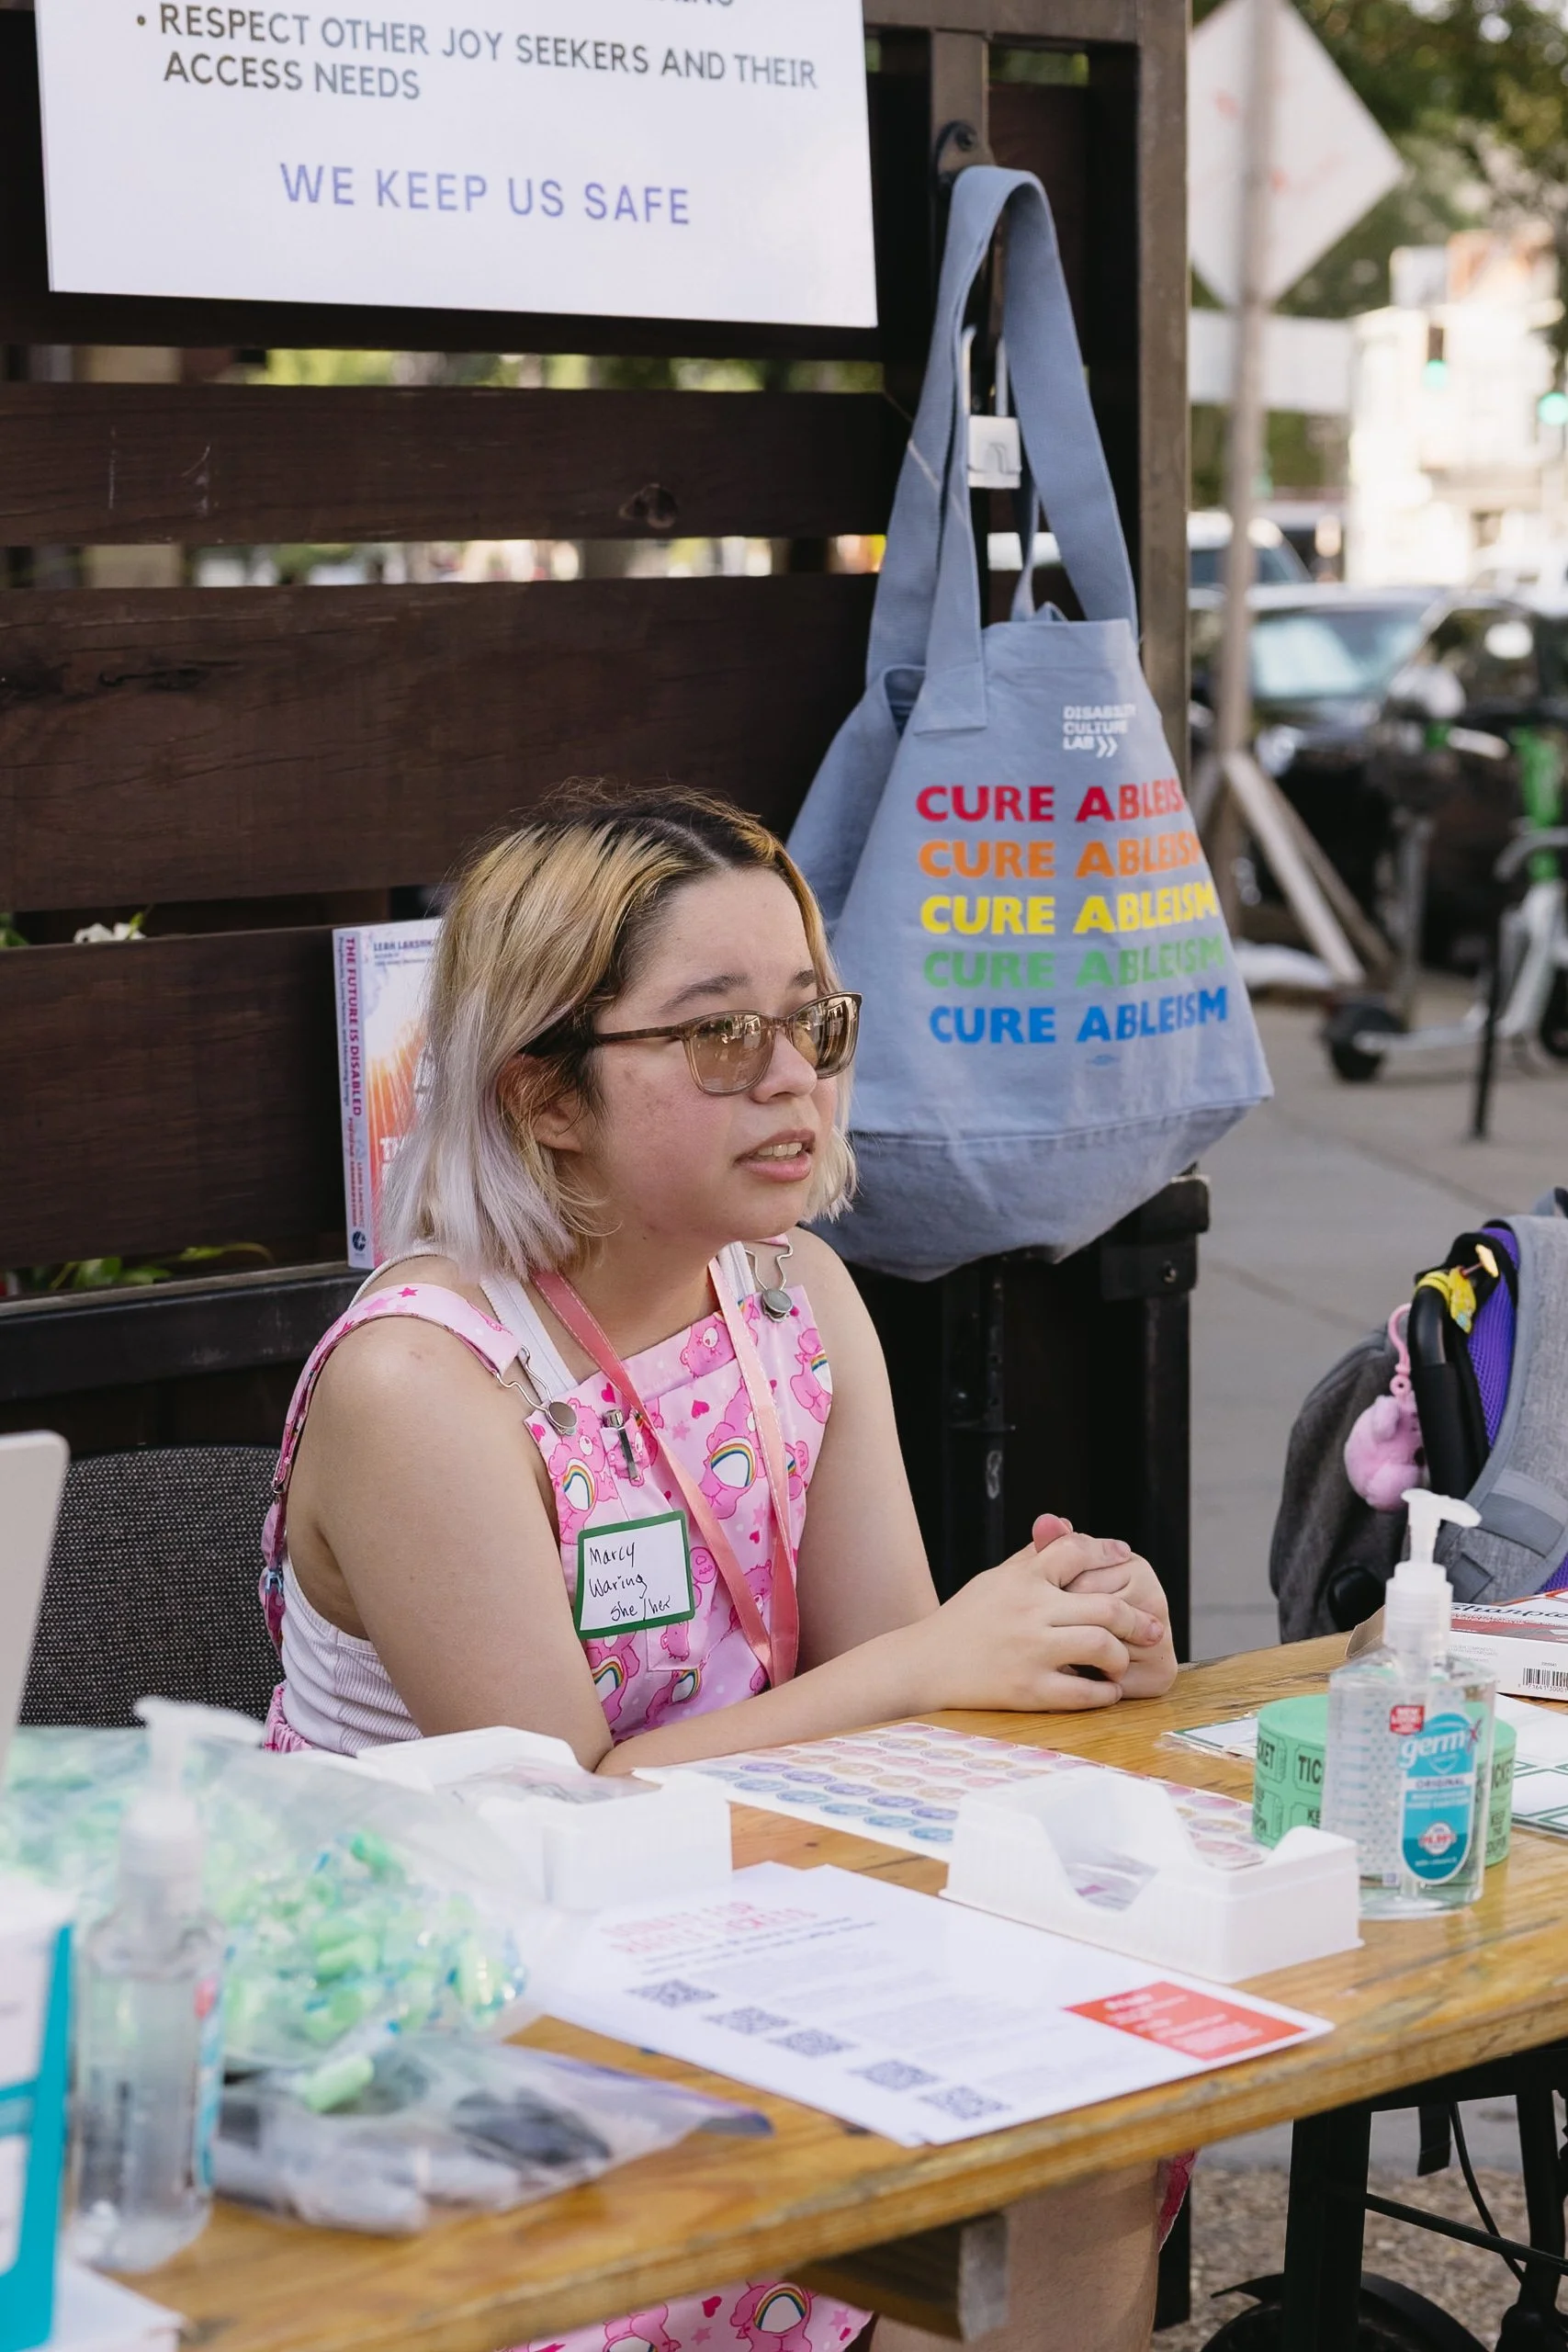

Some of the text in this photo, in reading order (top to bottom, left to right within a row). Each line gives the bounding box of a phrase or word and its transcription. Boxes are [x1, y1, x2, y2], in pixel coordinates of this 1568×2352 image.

[160, 4, 818, 89] RESPECT OTHER JOY SEEKERS AND THEIR
[164, 51, 421, 99] ACCESS NEEDS
[280, 163, 690, 224] WE KEEP US SAFE
[1063, 735, 1094, 750] LAB
[916, 778, 1185, 822] CURE ABLEIS
[918, 840, 1055, 879] CURE
[920, 881, 1219, 935] CURE ABLEISM
[346, 937, 356, 964] THE
[922, 934, 1225, 989] CURE ABLEISM
[347, 968, 359, 1024] FUTURE
[929, 986, 1228, 1045] CURE ABLEISM
[350, 1029, 359, 1042] IS
[350, 1046, 362, 1116] DISABLED
[589, 1542, 635, 1567] Marcy
[589, 1574, 648, 1600] Waring
[1298, 1755, 1323, 1784] TIC
